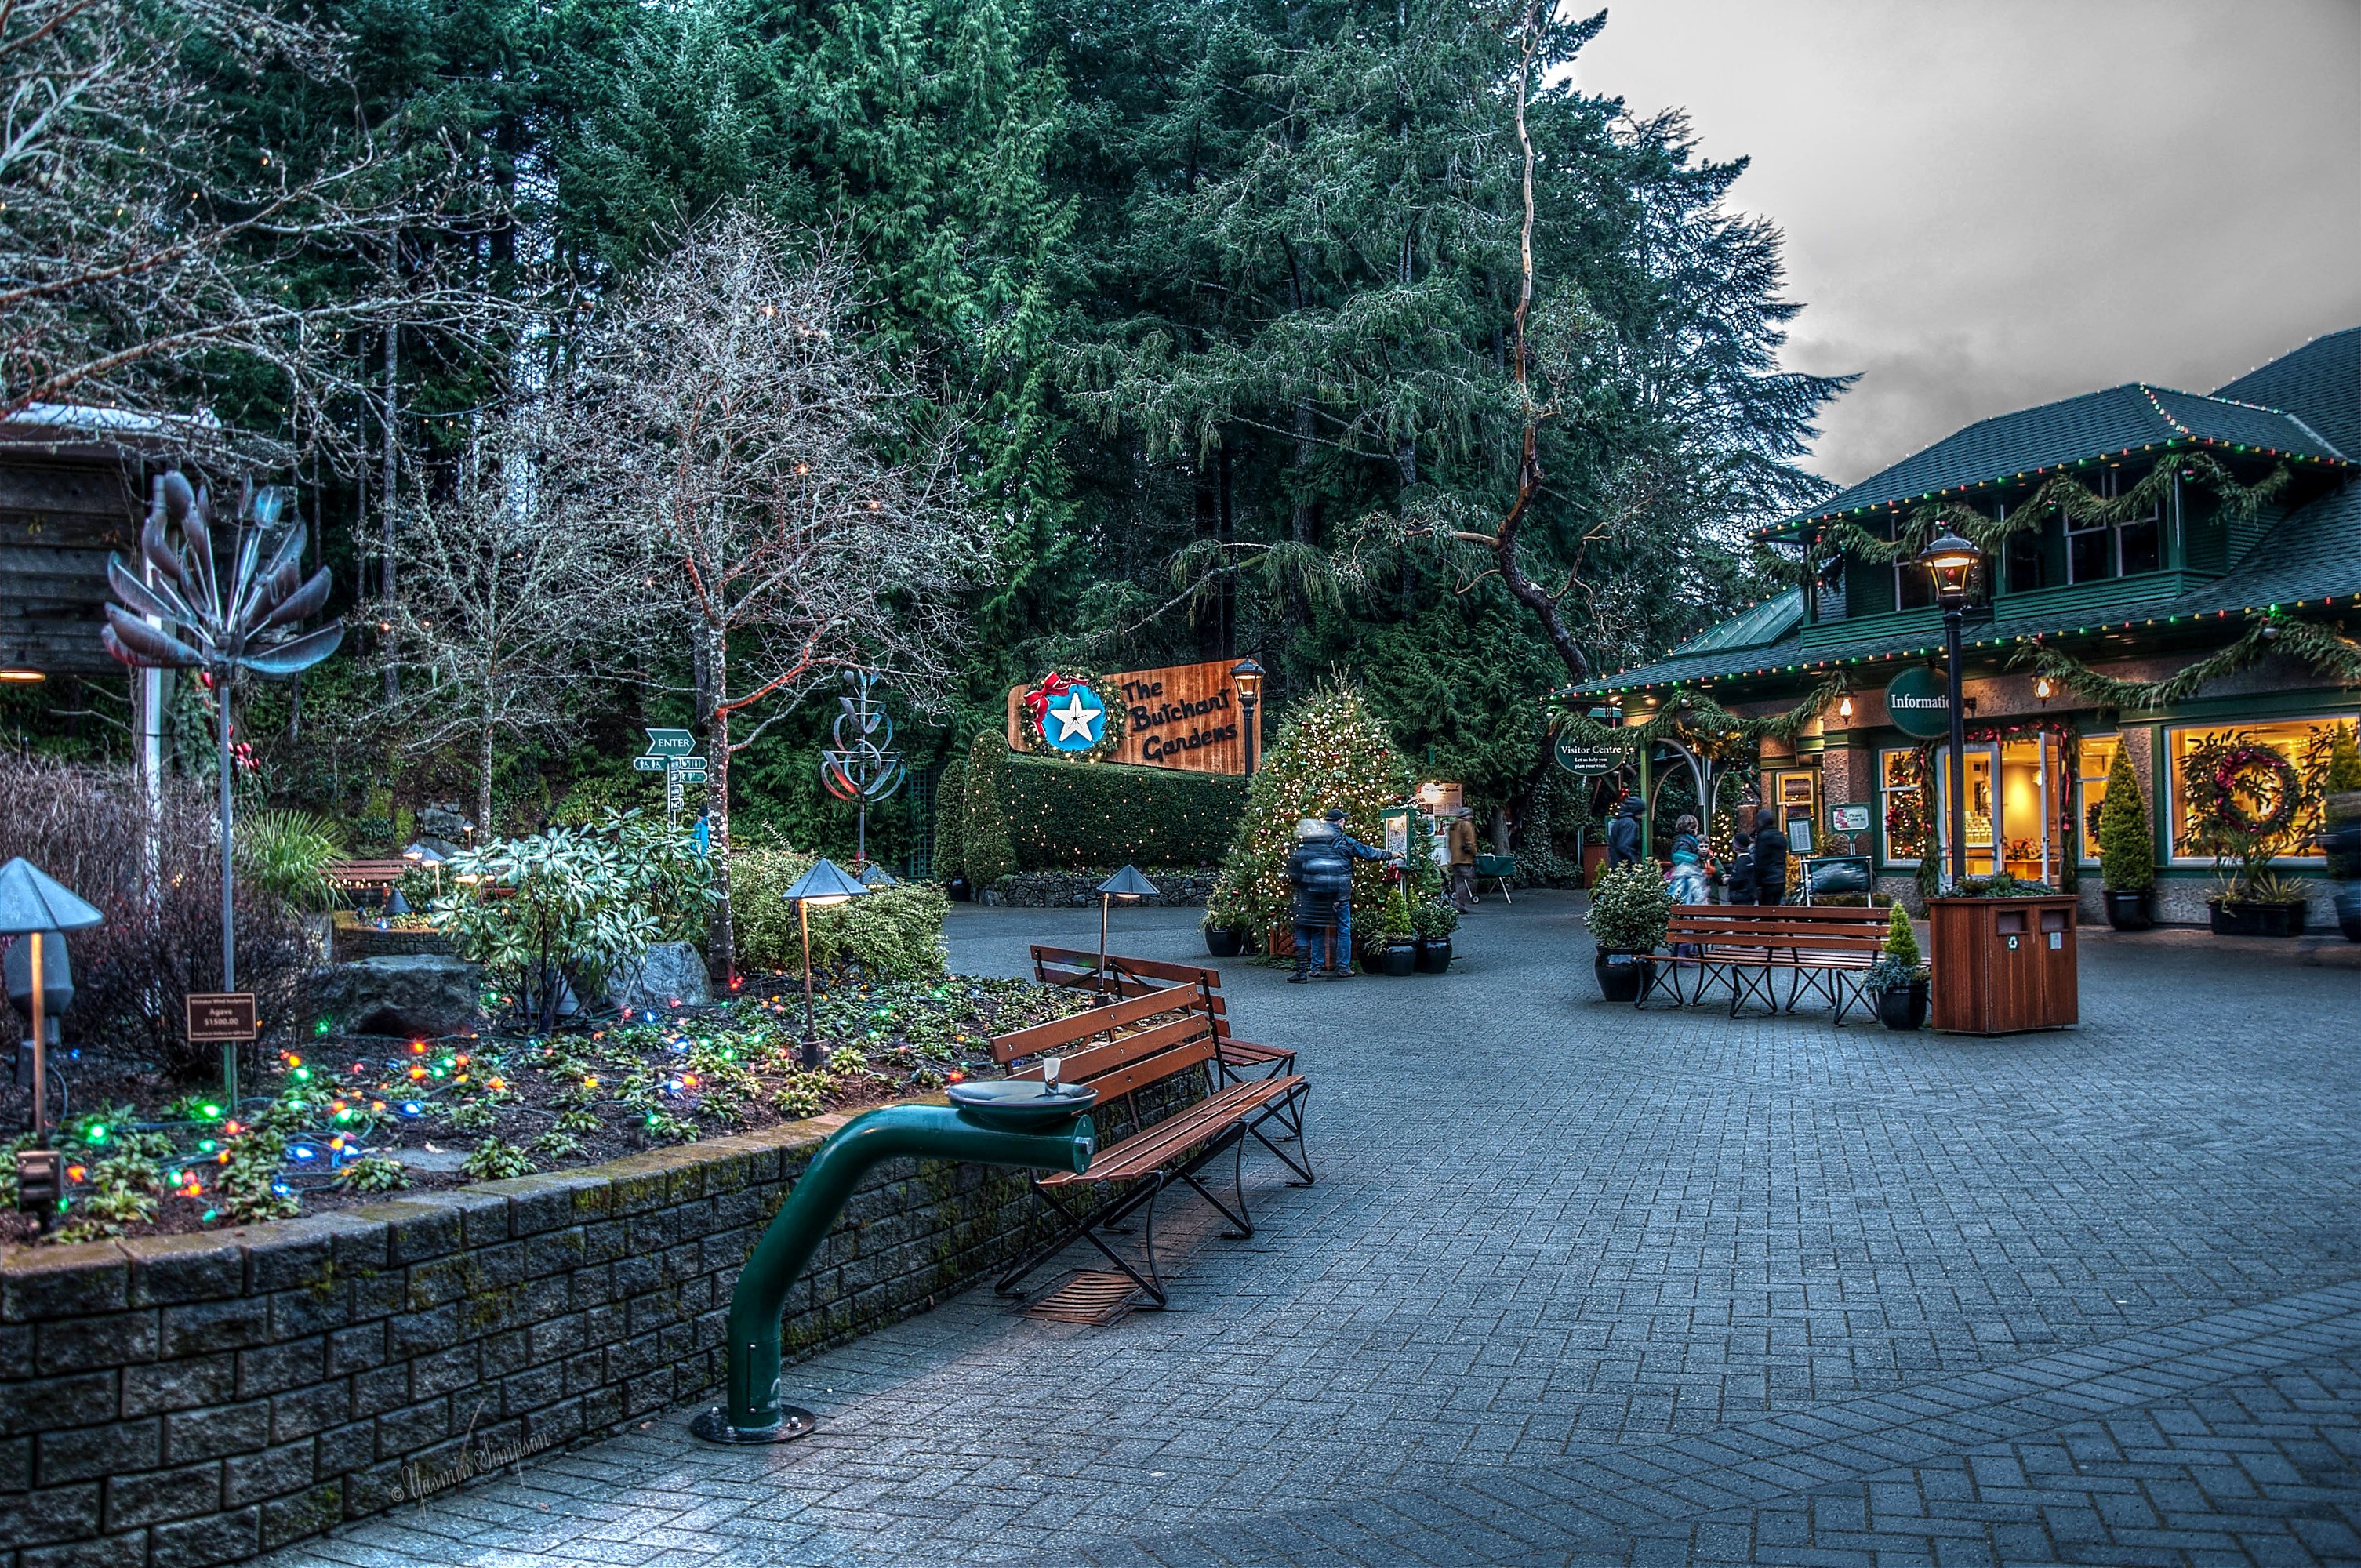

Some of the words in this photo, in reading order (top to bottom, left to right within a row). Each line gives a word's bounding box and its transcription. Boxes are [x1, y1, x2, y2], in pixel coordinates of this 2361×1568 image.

[1121, 679, 1163, 702] The
[1128, 689, 1230, 732] Butchart
[658, 739, 690, 747] ENTER
[1142, 724, 1237, 762] Gardens
[1561, 746, 1590, 754] Visitor
[209, 1008, 233, 1017] Agave
